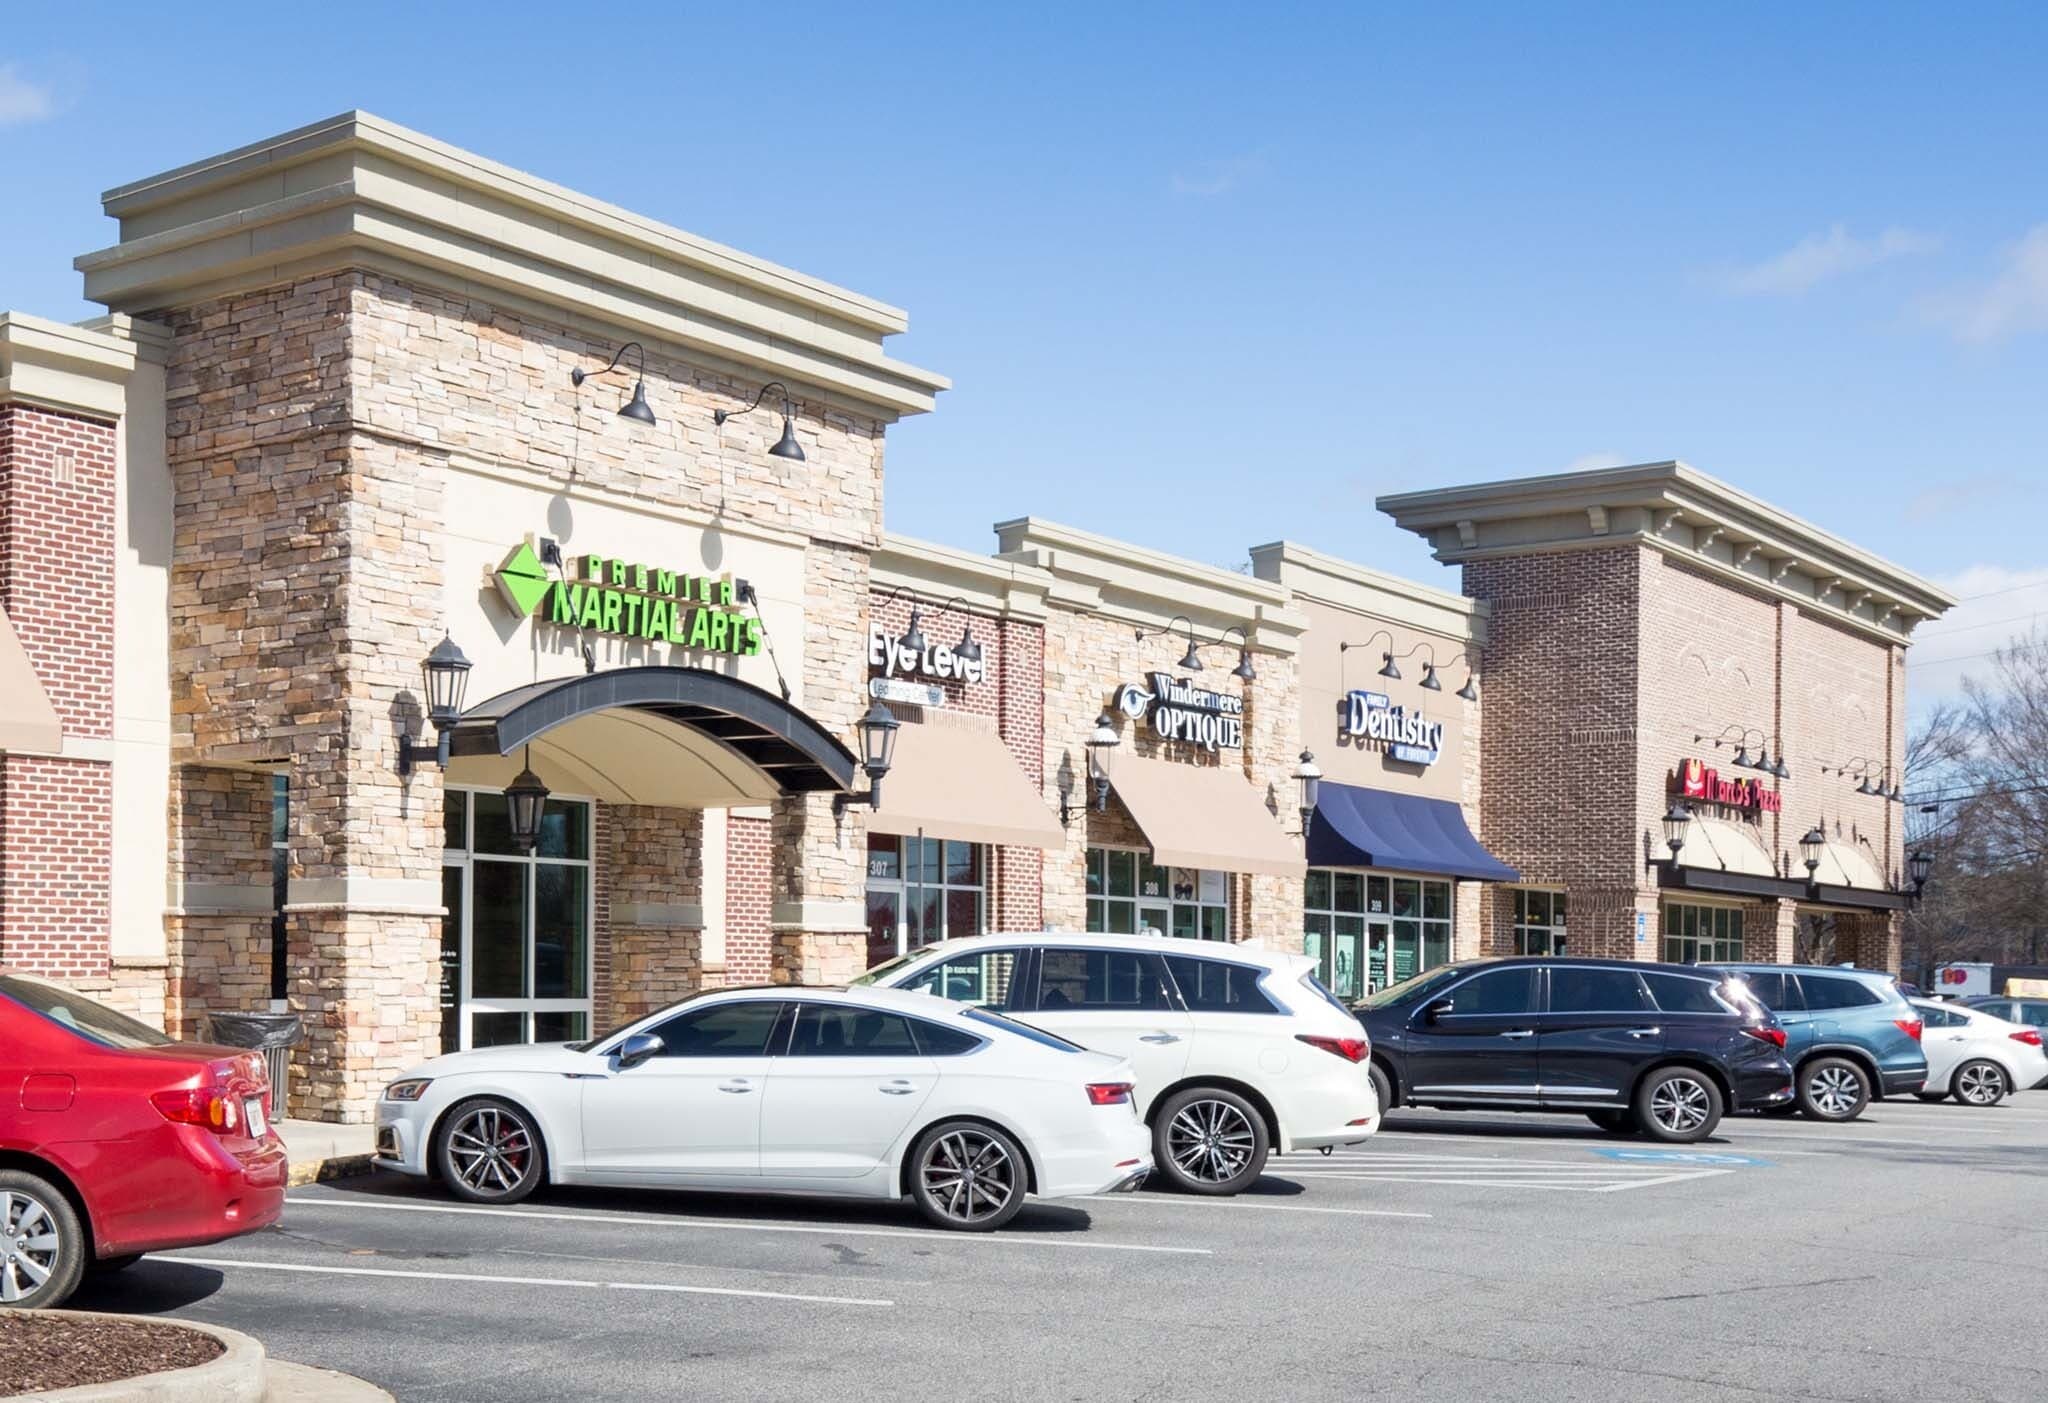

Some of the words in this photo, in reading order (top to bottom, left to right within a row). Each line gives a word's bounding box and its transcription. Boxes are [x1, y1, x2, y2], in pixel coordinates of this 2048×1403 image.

[588, 554, 732, 606] PREMIER
[552, 578, 685, 645] MARTIAL
[690, 606, 762, 656] ARTS
[869, 621, 918, 678] Eye
[922, 631, 985, 684] Level
[1154, 673, 1242, 714] Windermere
[1155, 706, 1241, 752] OPTIQUE
[1350, 692, 1444, 766] Dentistry
[870, 860, 888, 876] 307
